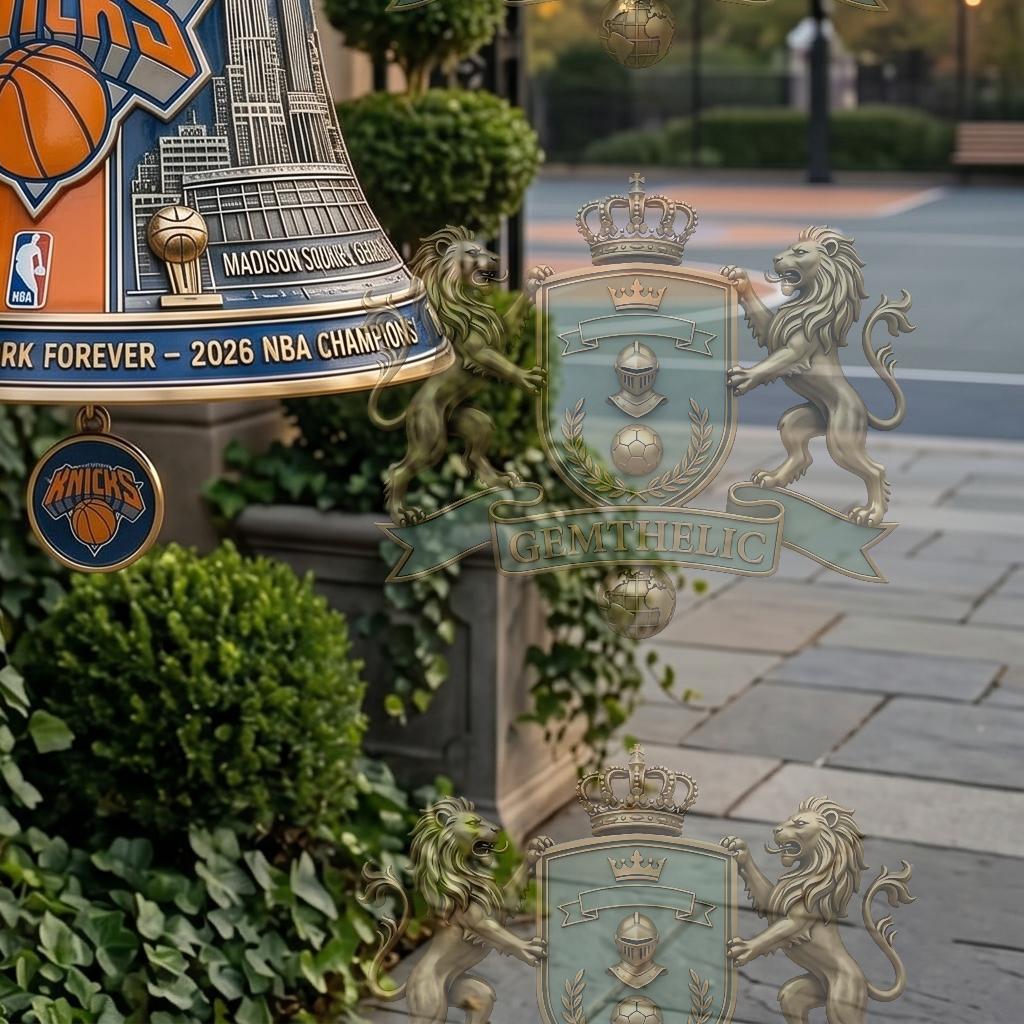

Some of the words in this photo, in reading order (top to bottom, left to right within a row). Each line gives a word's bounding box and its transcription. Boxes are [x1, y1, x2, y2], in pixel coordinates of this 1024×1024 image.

[222, 247, 303, 277] MADISON
[11, 291, 32, 303] NBA
[43, 341, 157, 369] FOREVER
[191, 339, 254, 366] 2026
[262, 334, 312, 363] NBA
[44, 468, 144, 510] KNICKS
